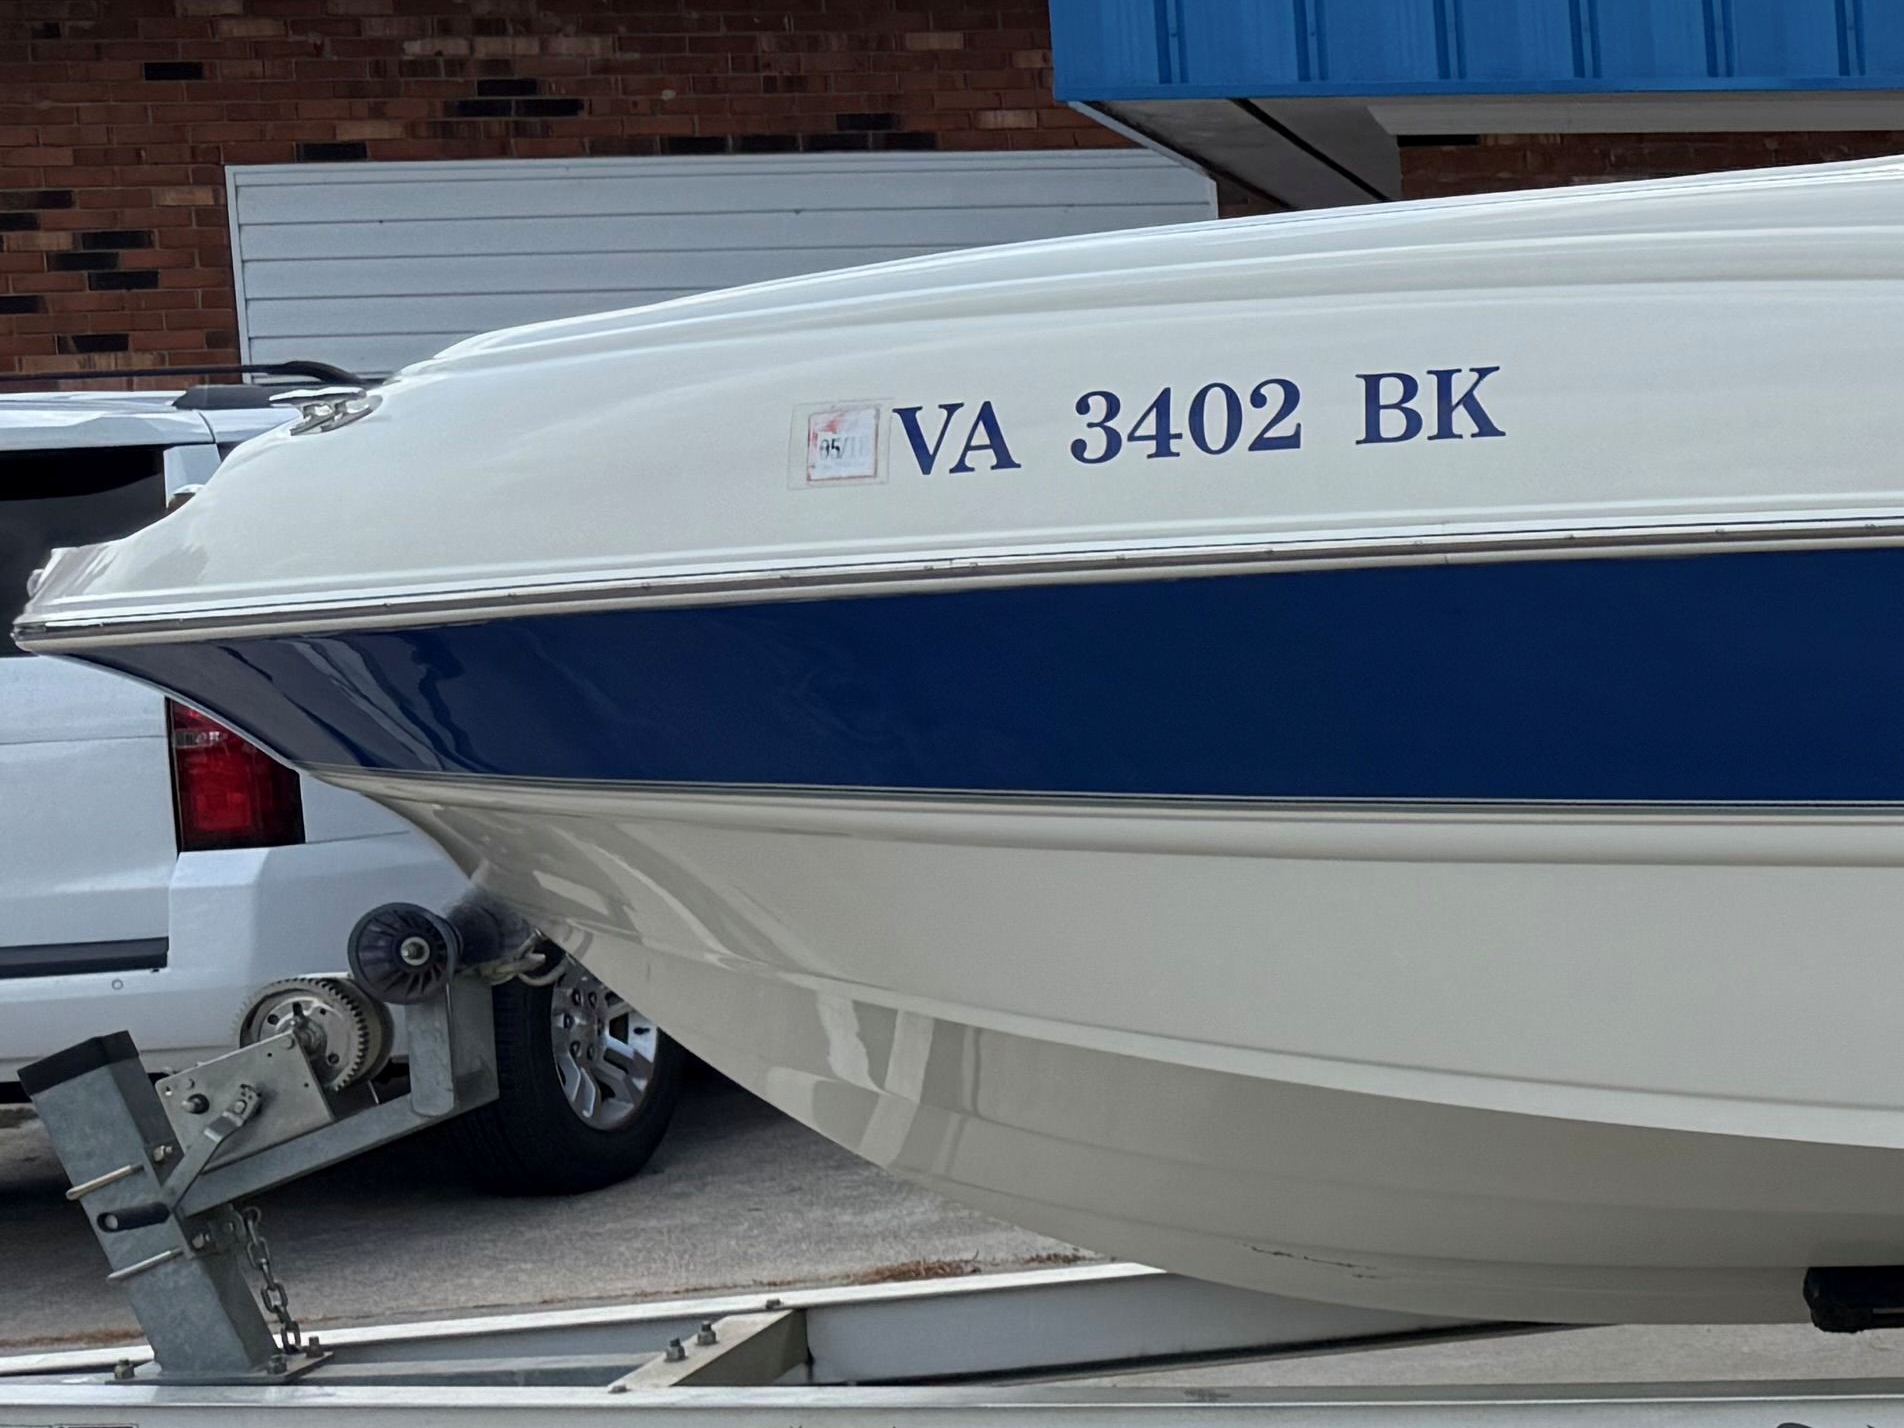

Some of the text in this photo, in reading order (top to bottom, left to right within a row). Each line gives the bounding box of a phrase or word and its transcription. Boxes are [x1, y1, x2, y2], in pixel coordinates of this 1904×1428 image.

[892, 366, 1506, 475] VA 3402 BK
